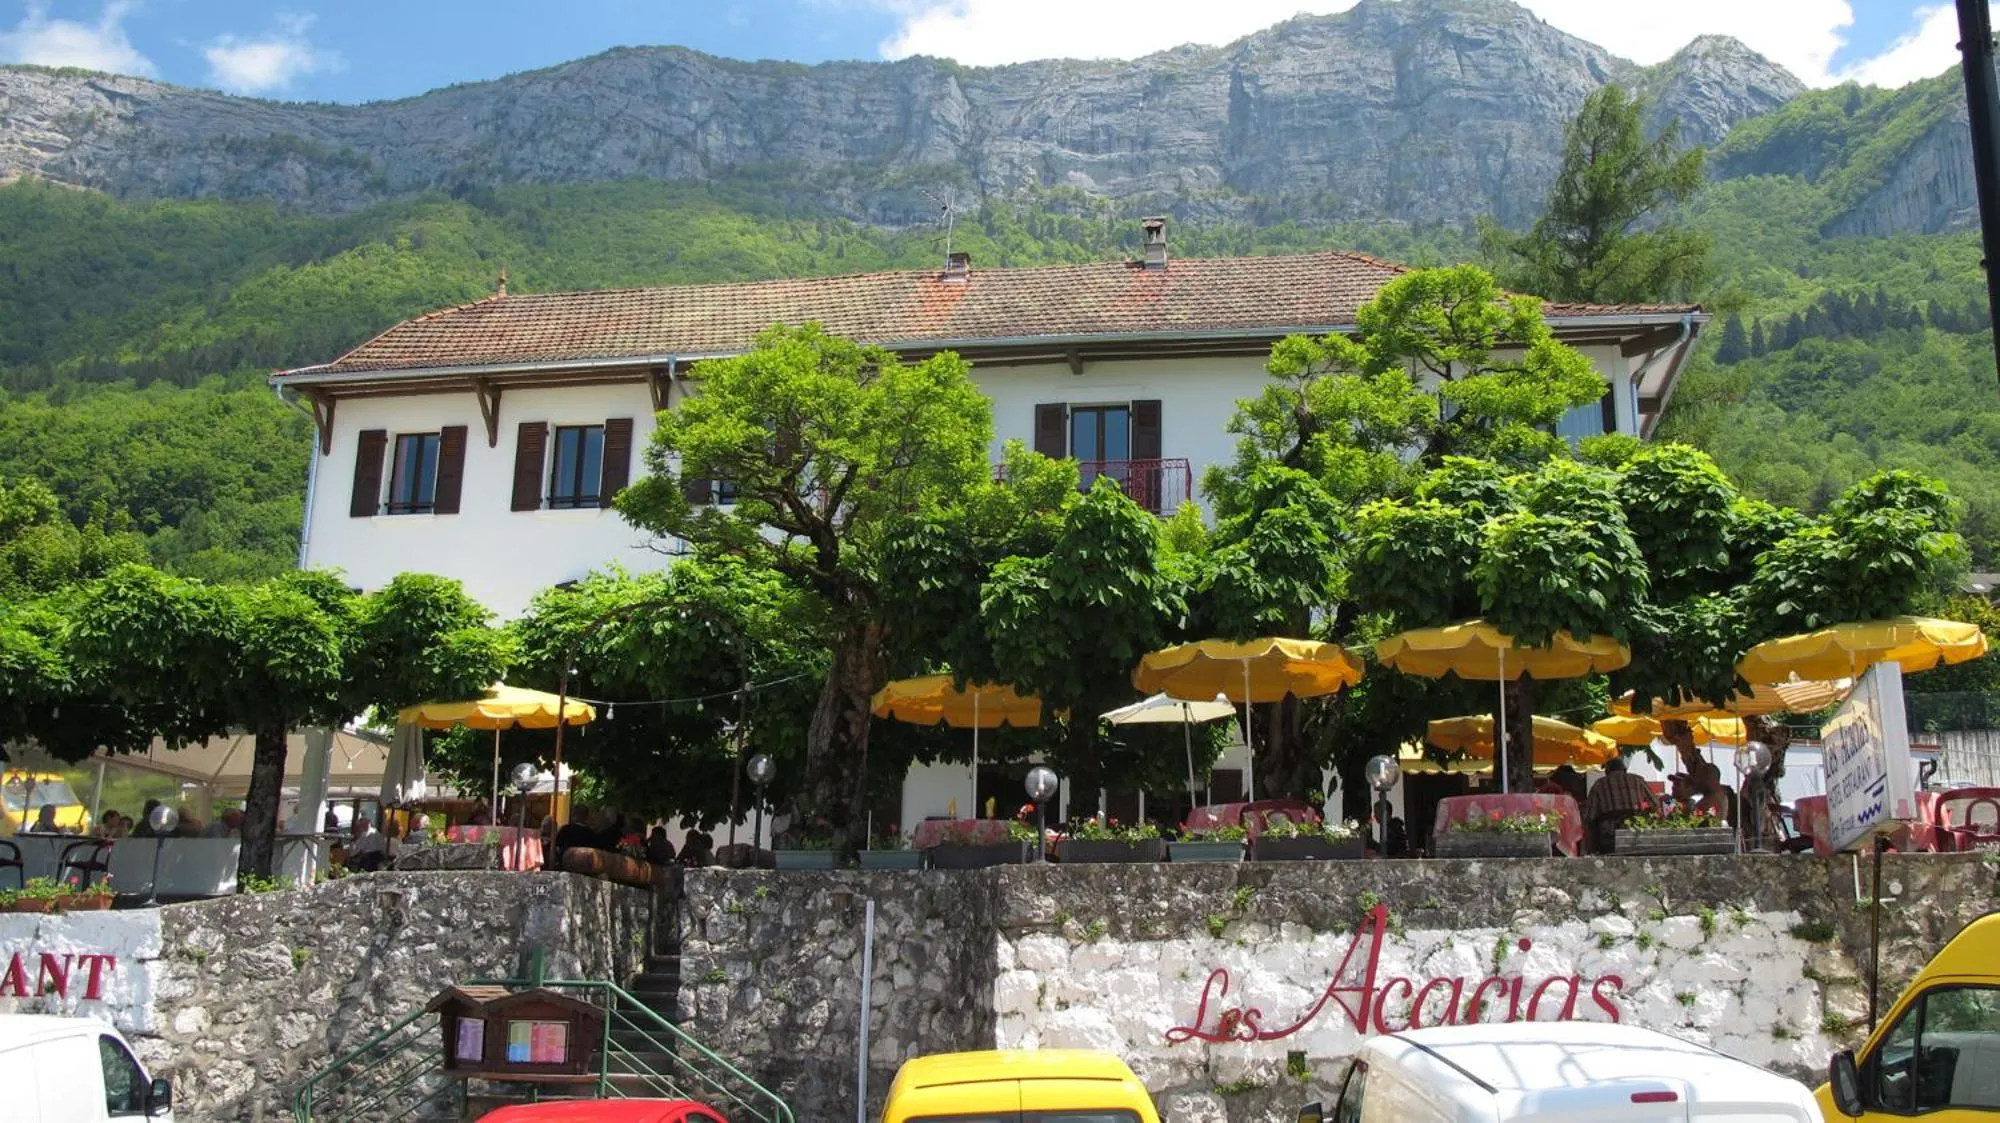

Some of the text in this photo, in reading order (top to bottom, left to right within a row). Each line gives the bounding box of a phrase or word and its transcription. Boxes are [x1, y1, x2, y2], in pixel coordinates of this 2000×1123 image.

[0, 951, 116, 1000] ANT
[1165, 903, 1624, 1043] Les Acacias
